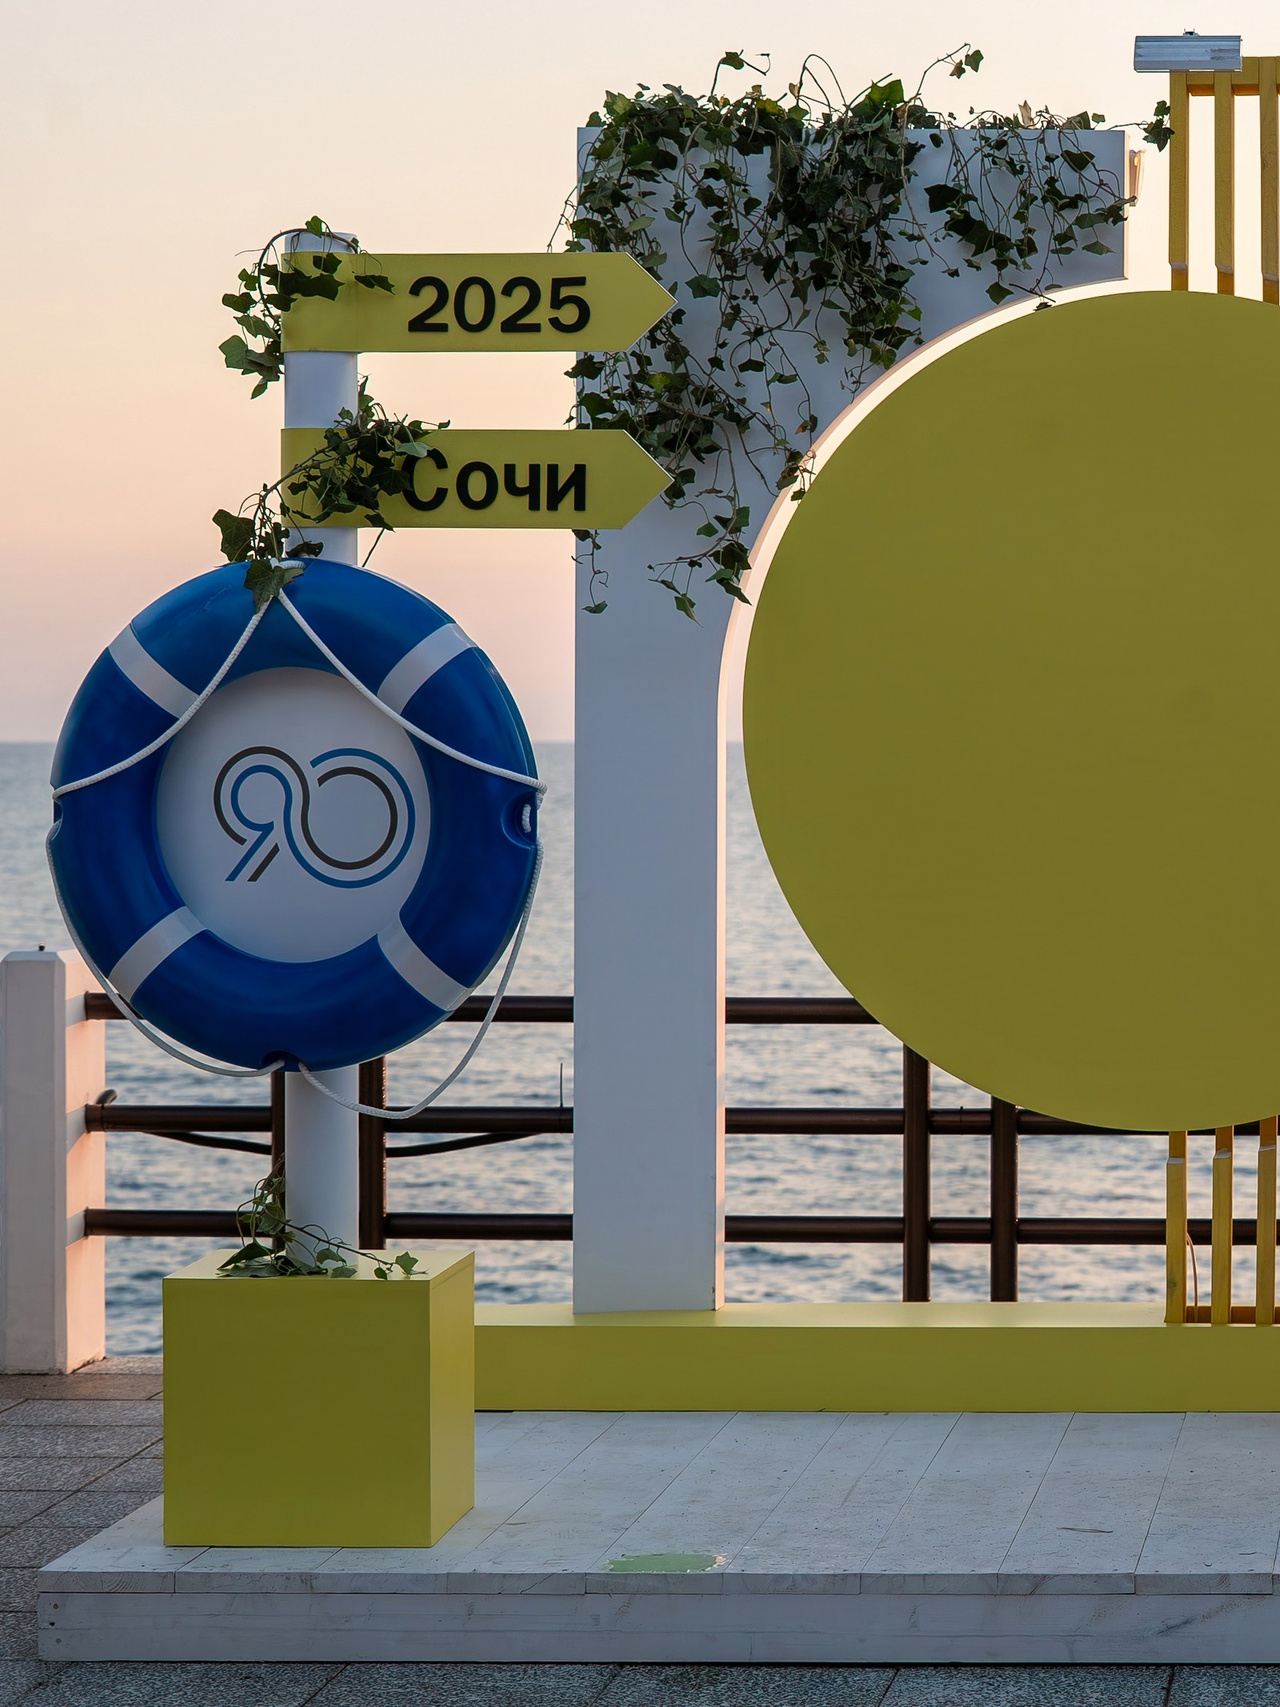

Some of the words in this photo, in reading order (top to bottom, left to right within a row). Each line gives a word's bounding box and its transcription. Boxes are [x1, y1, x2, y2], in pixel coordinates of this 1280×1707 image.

[408, 277, 590, 333] 2025
[401, 447, 588, 512] Сочи
[213, 745, 417, 890] 90
